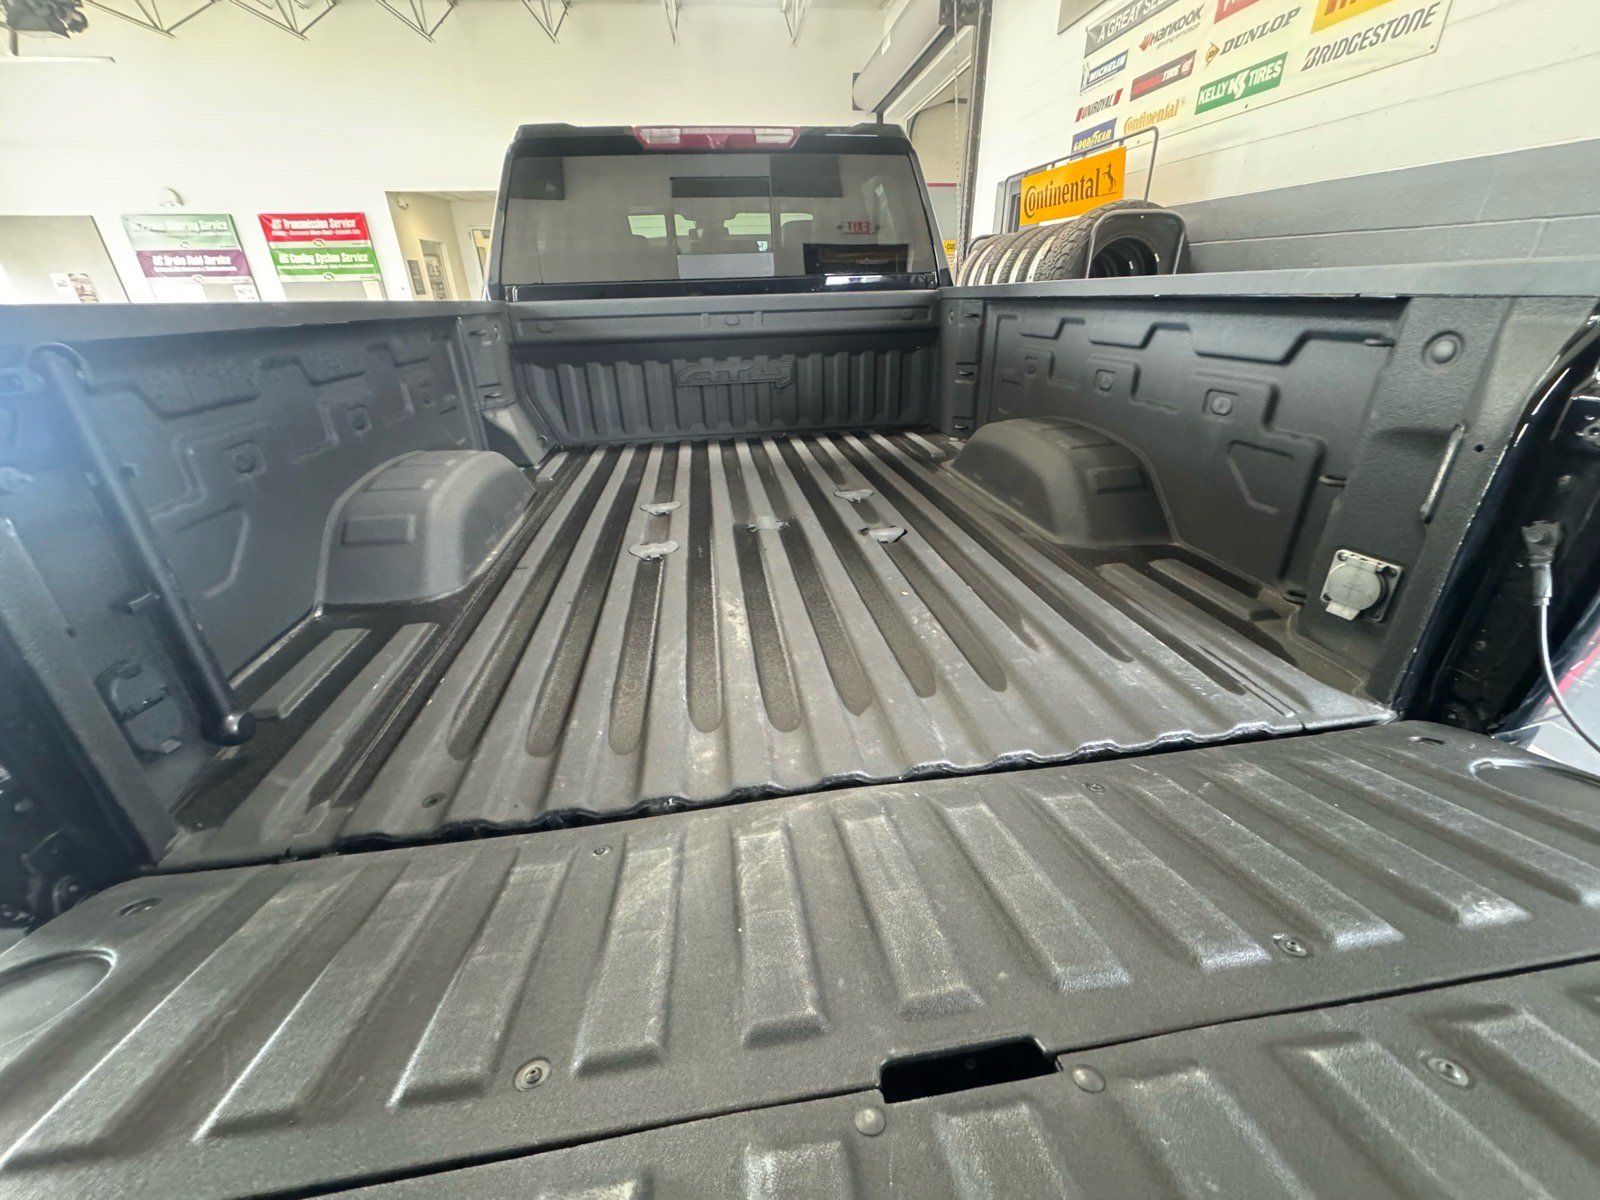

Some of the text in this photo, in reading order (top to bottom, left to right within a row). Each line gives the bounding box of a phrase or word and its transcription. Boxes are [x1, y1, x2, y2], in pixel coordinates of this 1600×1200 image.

[1096, 24, 1106, 44] A
[1107, 0, 1143, 37] GREAT
[1219, 7, 1301, 56] DUNLOP
[1300, 1, 1441, 72] BRIDGESTONE
[1198, 80, 1229, 106] KELLY
[1248, 59, 1283, 87] TIRES
[1123, 99, 1179, 135] Continental
[1023, 169, 1100, 219] Continental
[329, 217, 356, 228] Service
[203, 254, 232, 265] Service
[340, 252, 368, 263] Service
